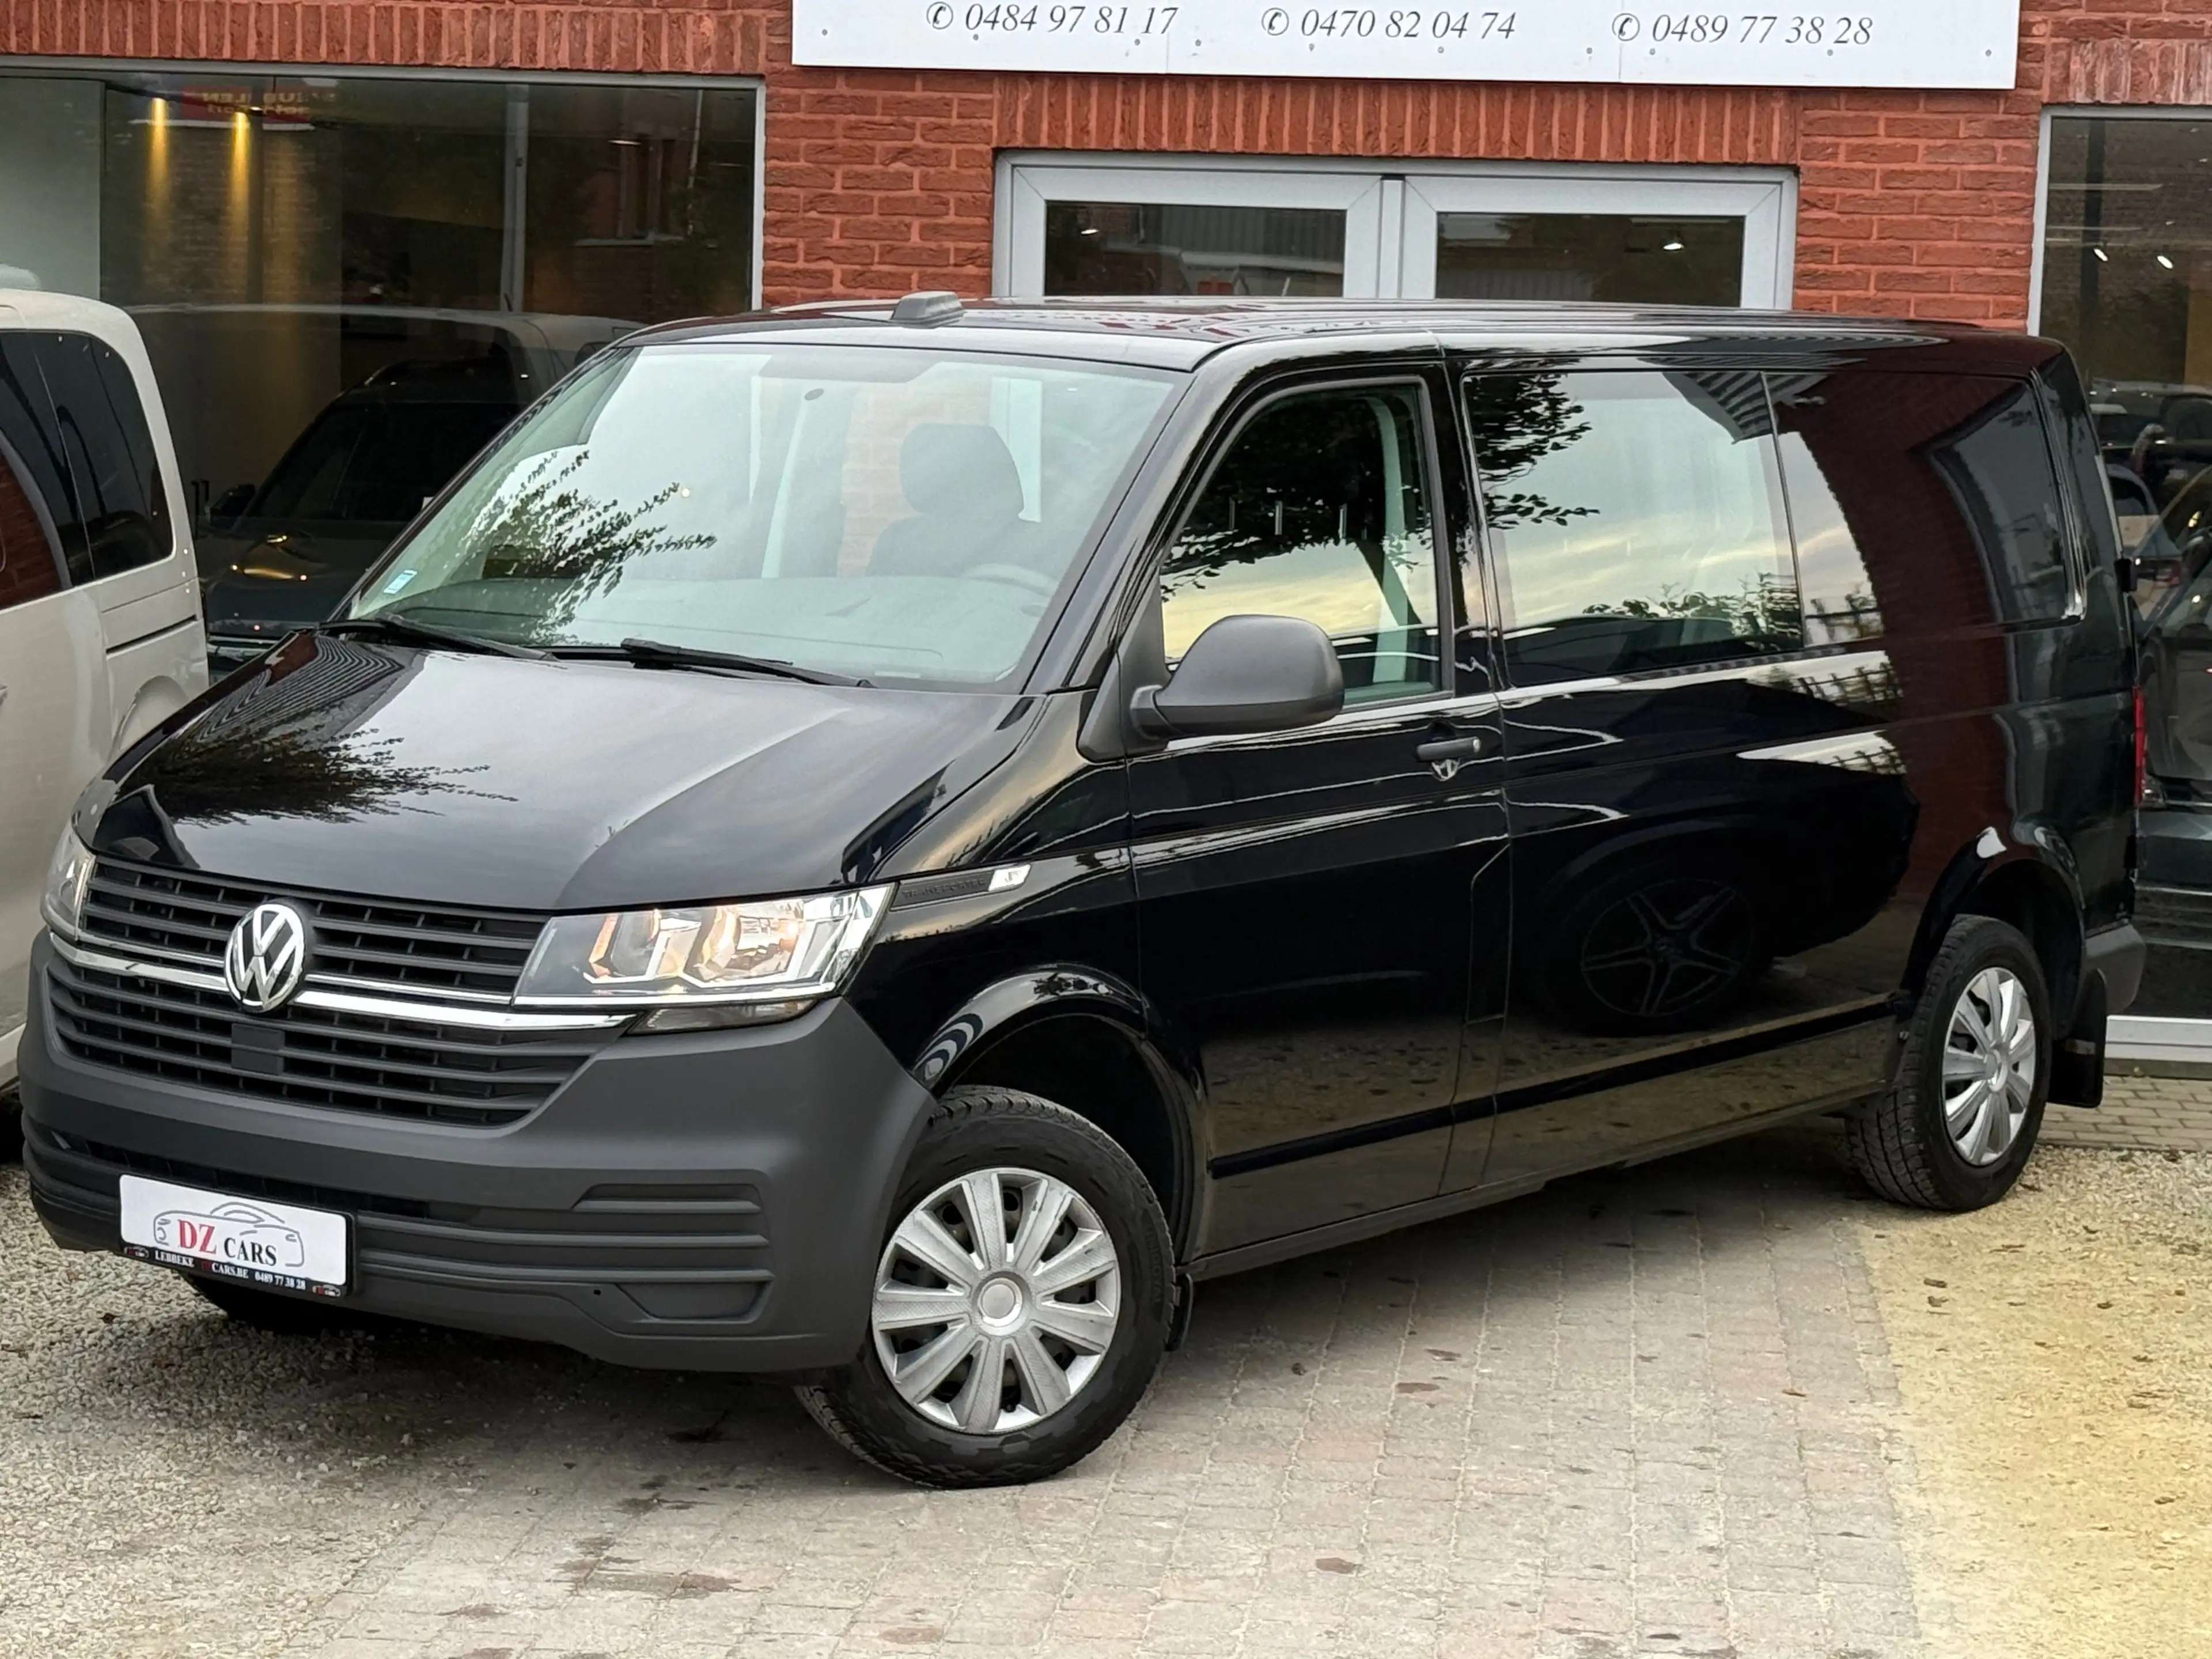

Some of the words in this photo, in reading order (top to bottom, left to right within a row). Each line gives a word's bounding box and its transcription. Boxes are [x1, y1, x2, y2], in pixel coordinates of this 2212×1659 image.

[965, 3, 1037, 31] 0484
[1047, 5, 1086, 33] 97
[1094, 6, 1128, 33] 81
[1141, 7, 1179, 35] 17
[1301, 9, 1376, 37] 0470
[1385, 10, 1421, 38] 82
[1431, 11, 1469, 39] 04
[1480, 12, 1517, 39] 74
[1652, 14, 1728, 43] 0489
[1740, 16, 1778, 44] 77
[1785, 16, 1825, 44] 38
[1833, 17, 1873, 45] 28
[177, 1219, 217, 1254] DZ
[224, 1237, 276, 1266] CARS
[254, 1271, 273, 1283] 0489
[274, 1275, 284, 1286] 77
